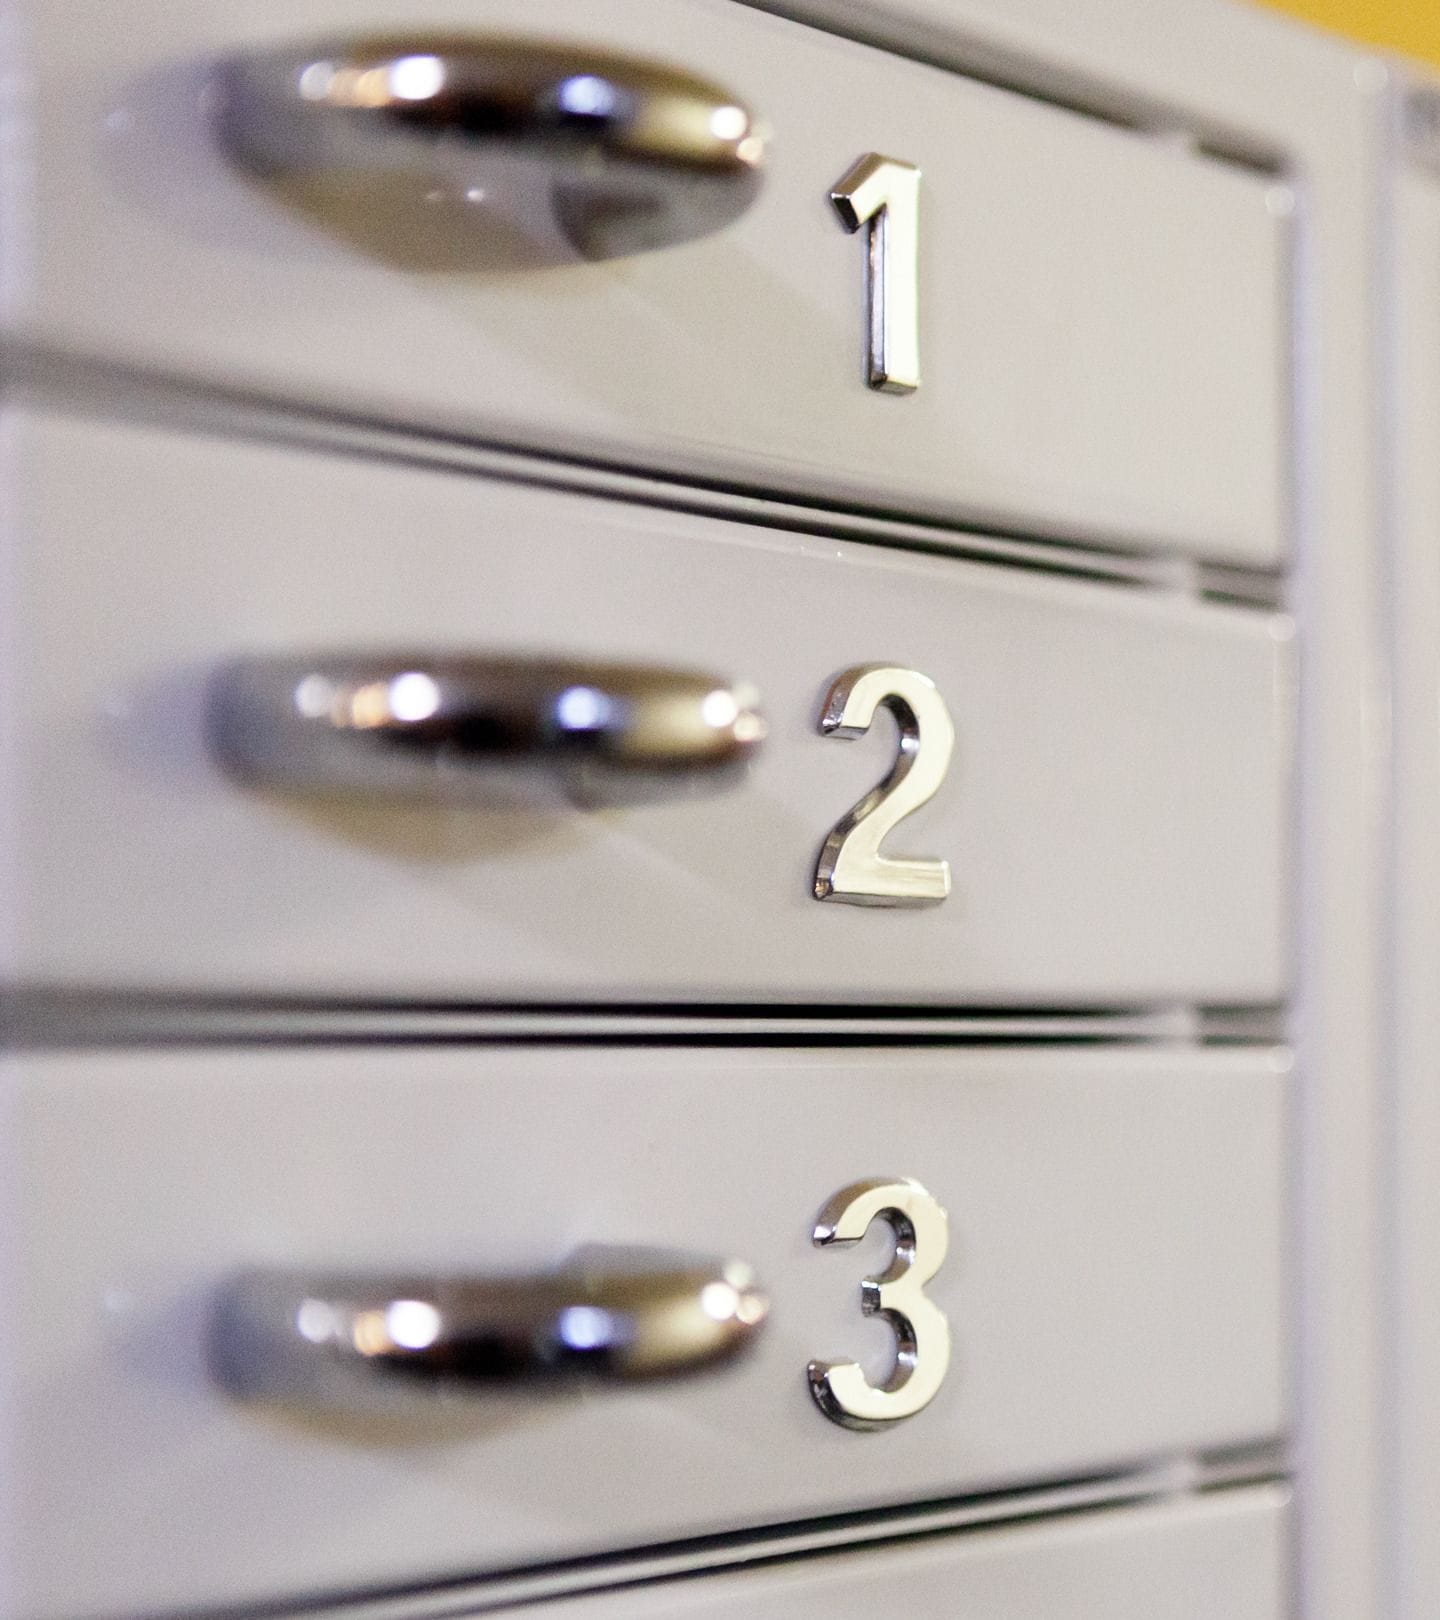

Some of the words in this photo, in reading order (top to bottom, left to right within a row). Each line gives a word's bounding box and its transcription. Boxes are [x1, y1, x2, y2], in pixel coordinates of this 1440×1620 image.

[828, 152, 921, 396] 1
[812, 661, 954, 908] 2
[806, 1177, 950, 1432] 3
